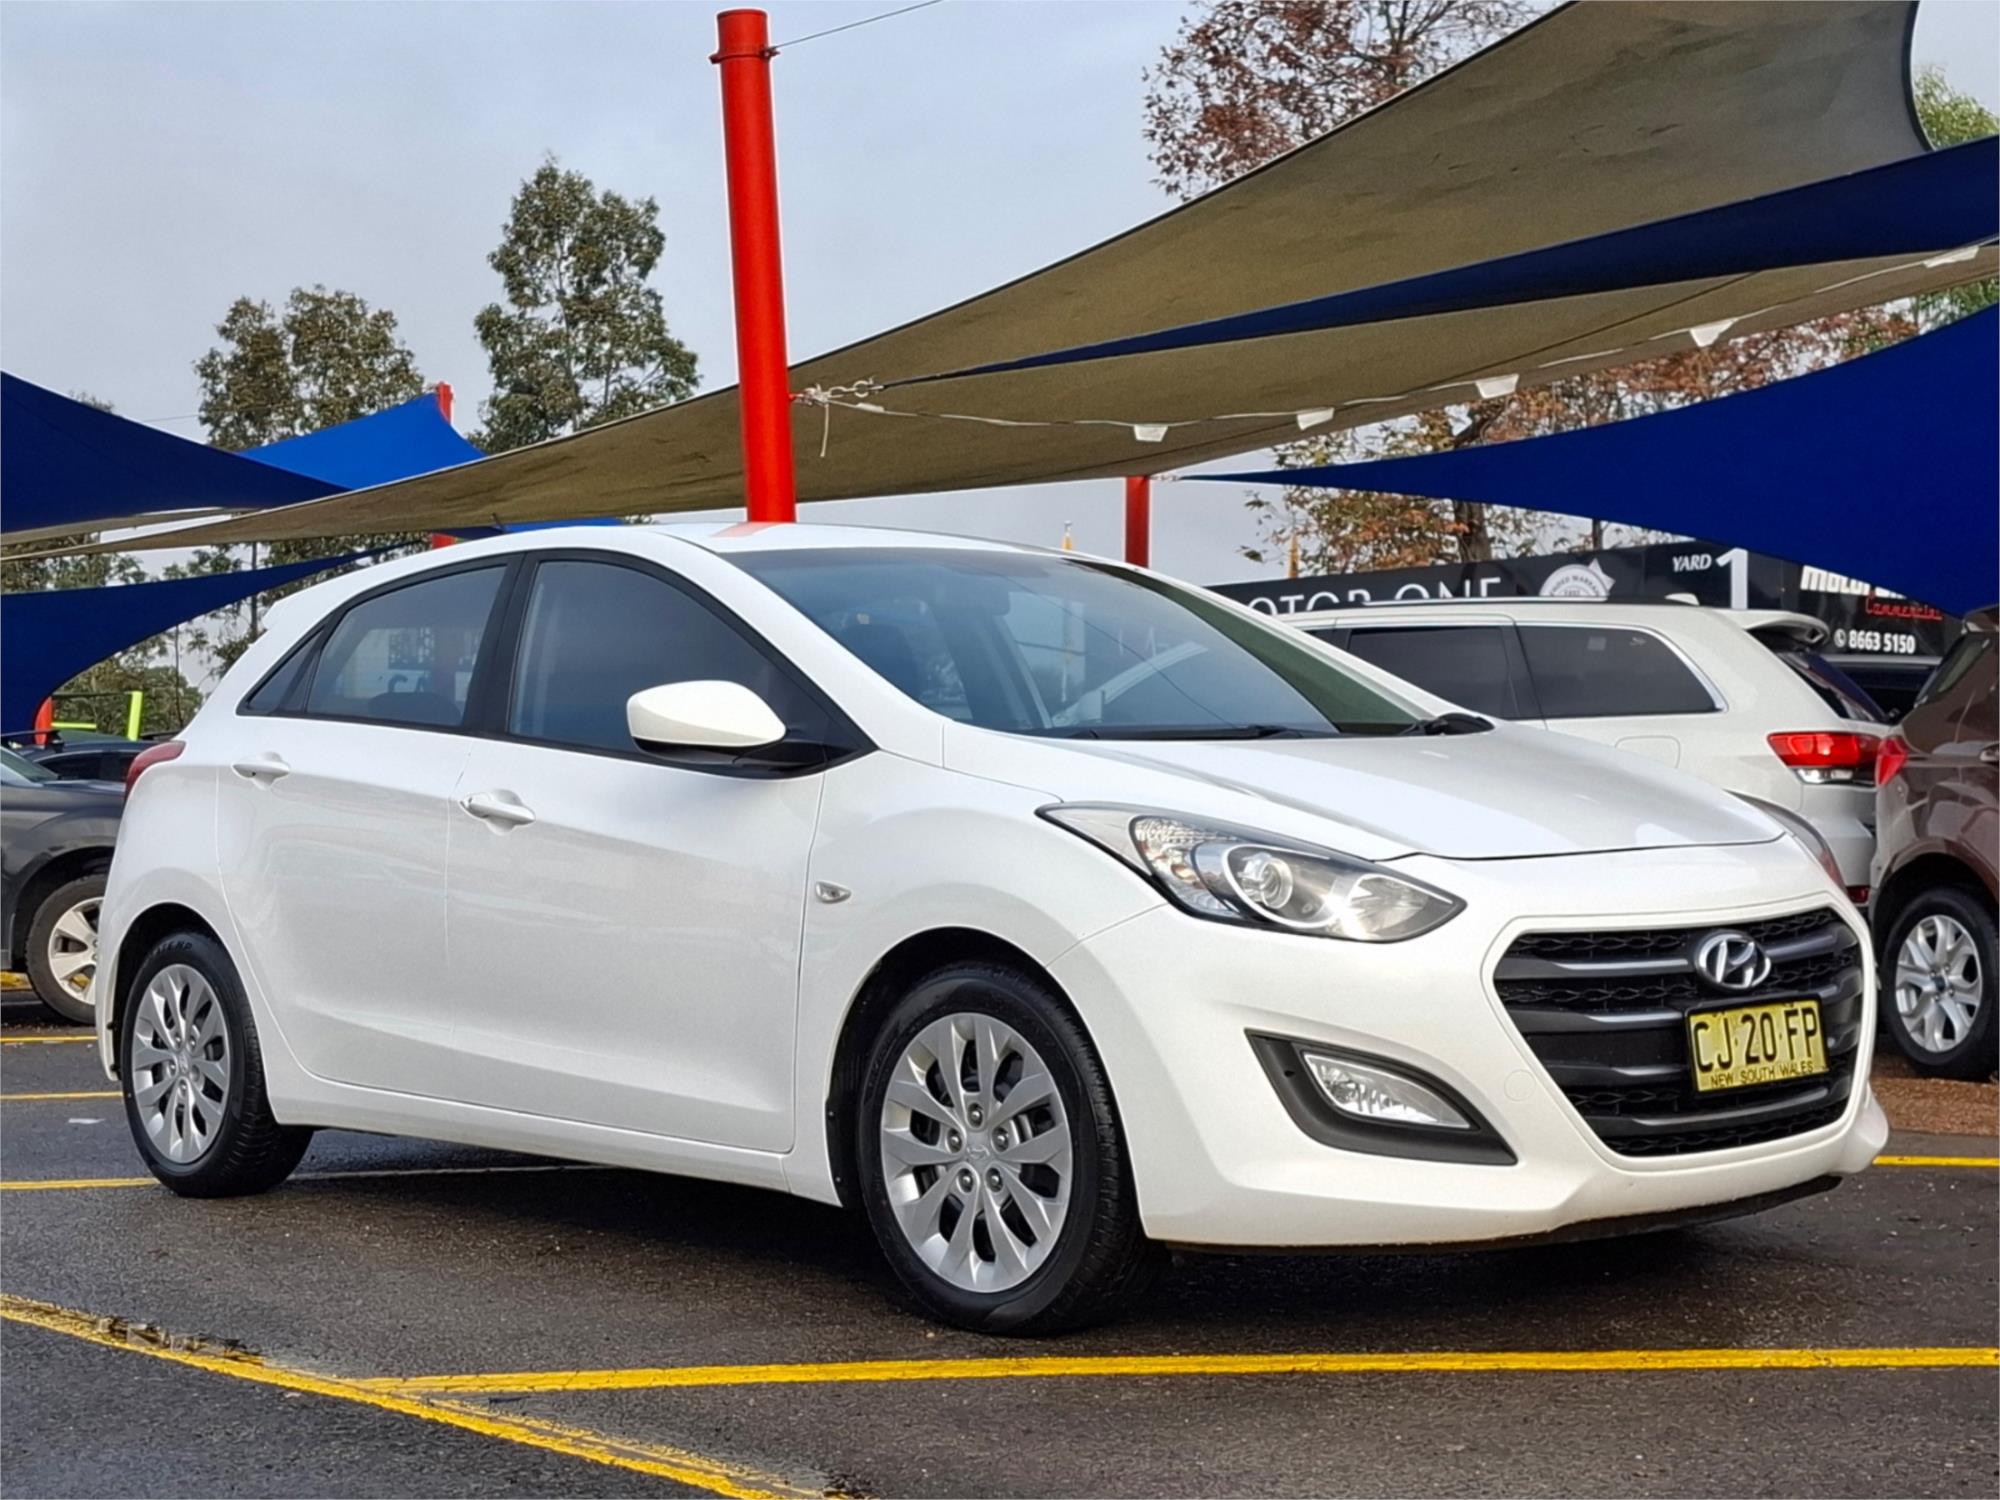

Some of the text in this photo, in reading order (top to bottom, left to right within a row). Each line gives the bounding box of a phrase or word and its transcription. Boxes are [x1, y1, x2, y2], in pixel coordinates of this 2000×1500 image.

[1672, 547, 1748, 609] YARD 1
[1848, 629, 1916, 654] 8663 5150
[1710, 1061, 1815, 1088] NEW SOUTH WALES
